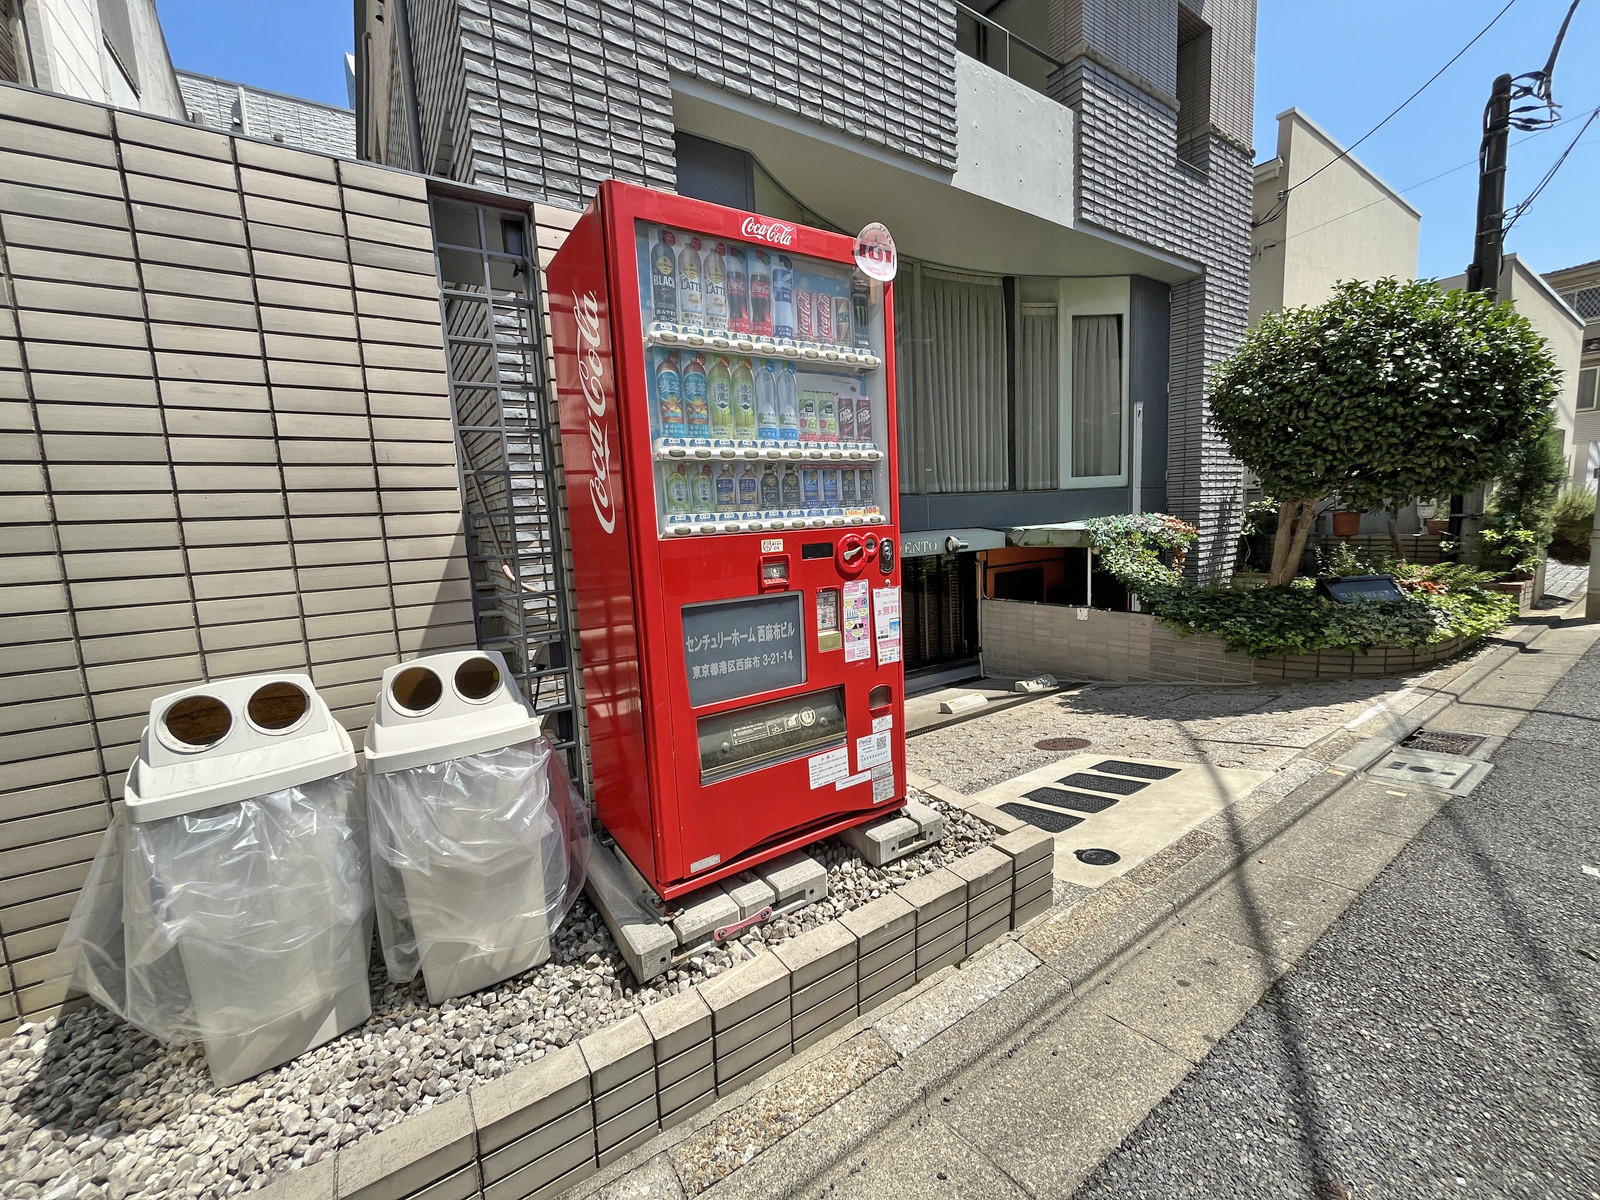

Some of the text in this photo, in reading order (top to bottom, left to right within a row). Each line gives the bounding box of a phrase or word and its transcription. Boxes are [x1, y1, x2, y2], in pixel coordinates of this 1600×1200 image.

[900, 541, 938, 554] ENTO
[686, 620, 795, 653] センチュリーホーム 西麻布ビル
[692, 649, 793, 680] 東京都港区西麻布 3-21-14
